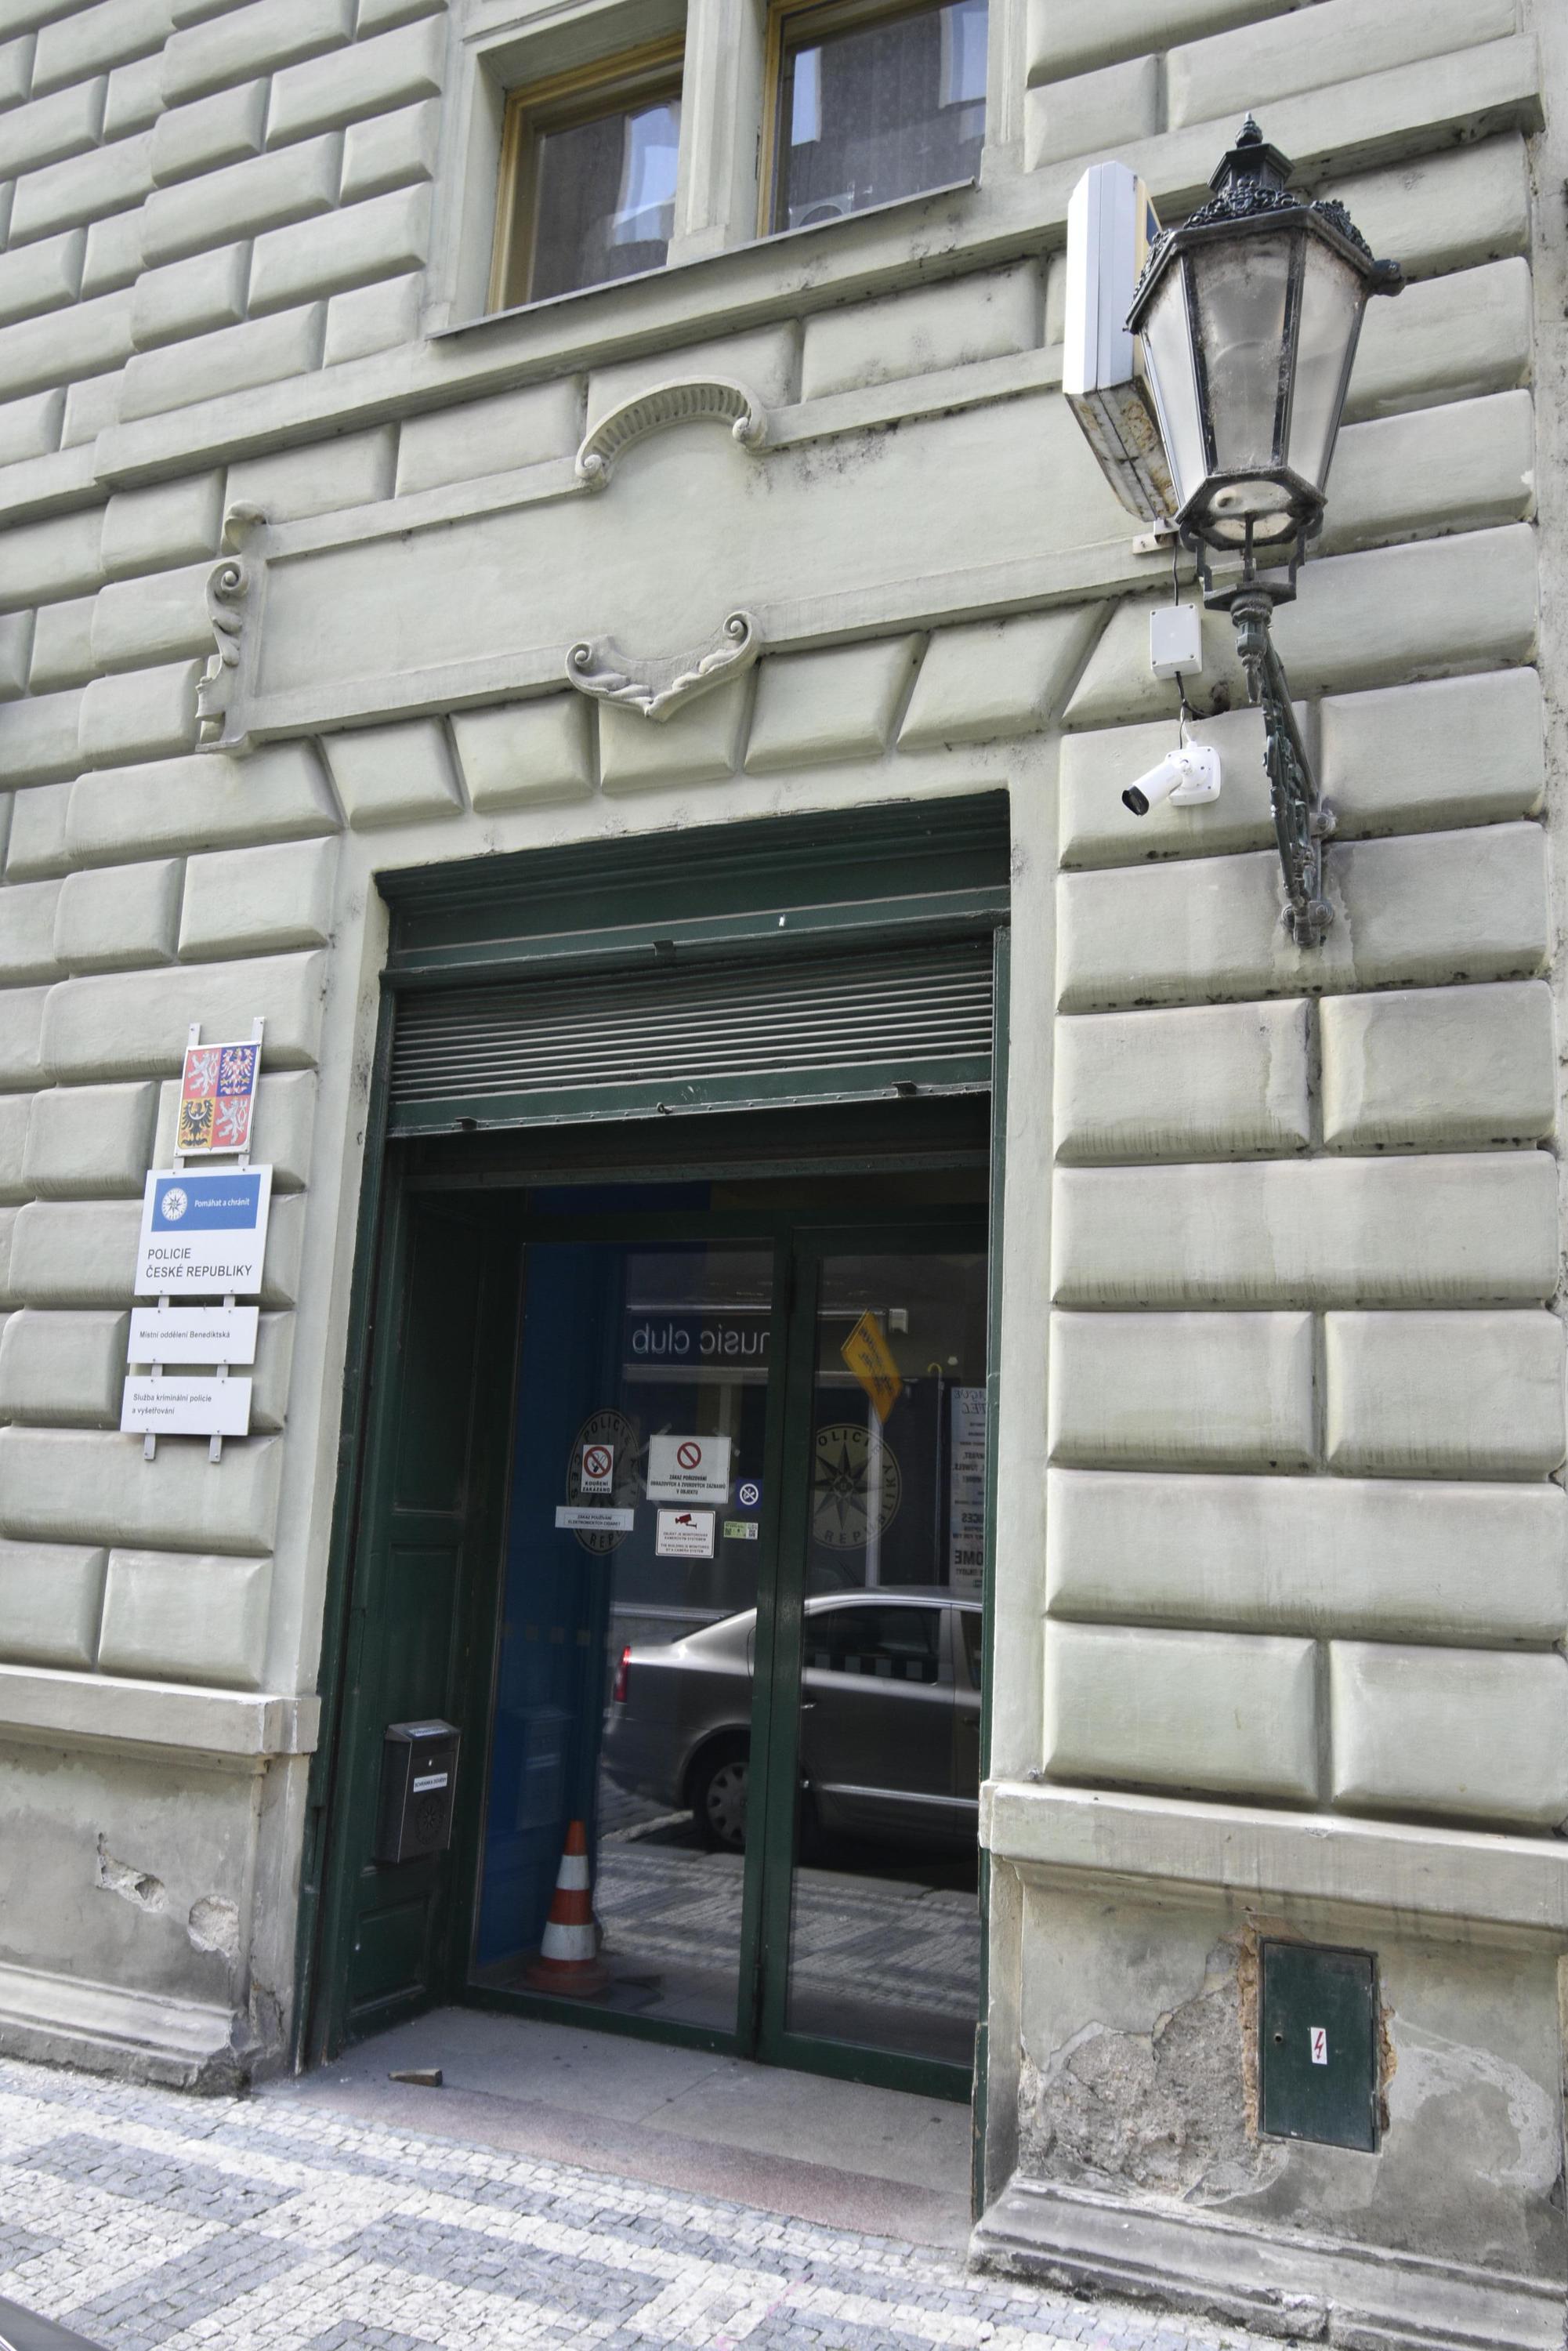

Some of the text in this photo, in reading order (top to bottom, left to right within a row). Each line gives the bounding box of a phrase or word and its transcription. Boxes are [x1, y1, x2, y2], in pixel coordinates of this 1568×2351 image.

[194, 1198, 222, 1208] Pomáhat
[227, 1197, 250, 1206] chránit
[147, 1248, 192, 1260] POLICIE
[146, 1263, 253, 1278] ČESKÉ REPUBLIKY
[133, 1393, 155, 1401] Služba
[189, 1394, 212, 1403] policie
[138, 1407, 175, 1415] vyšetřování
